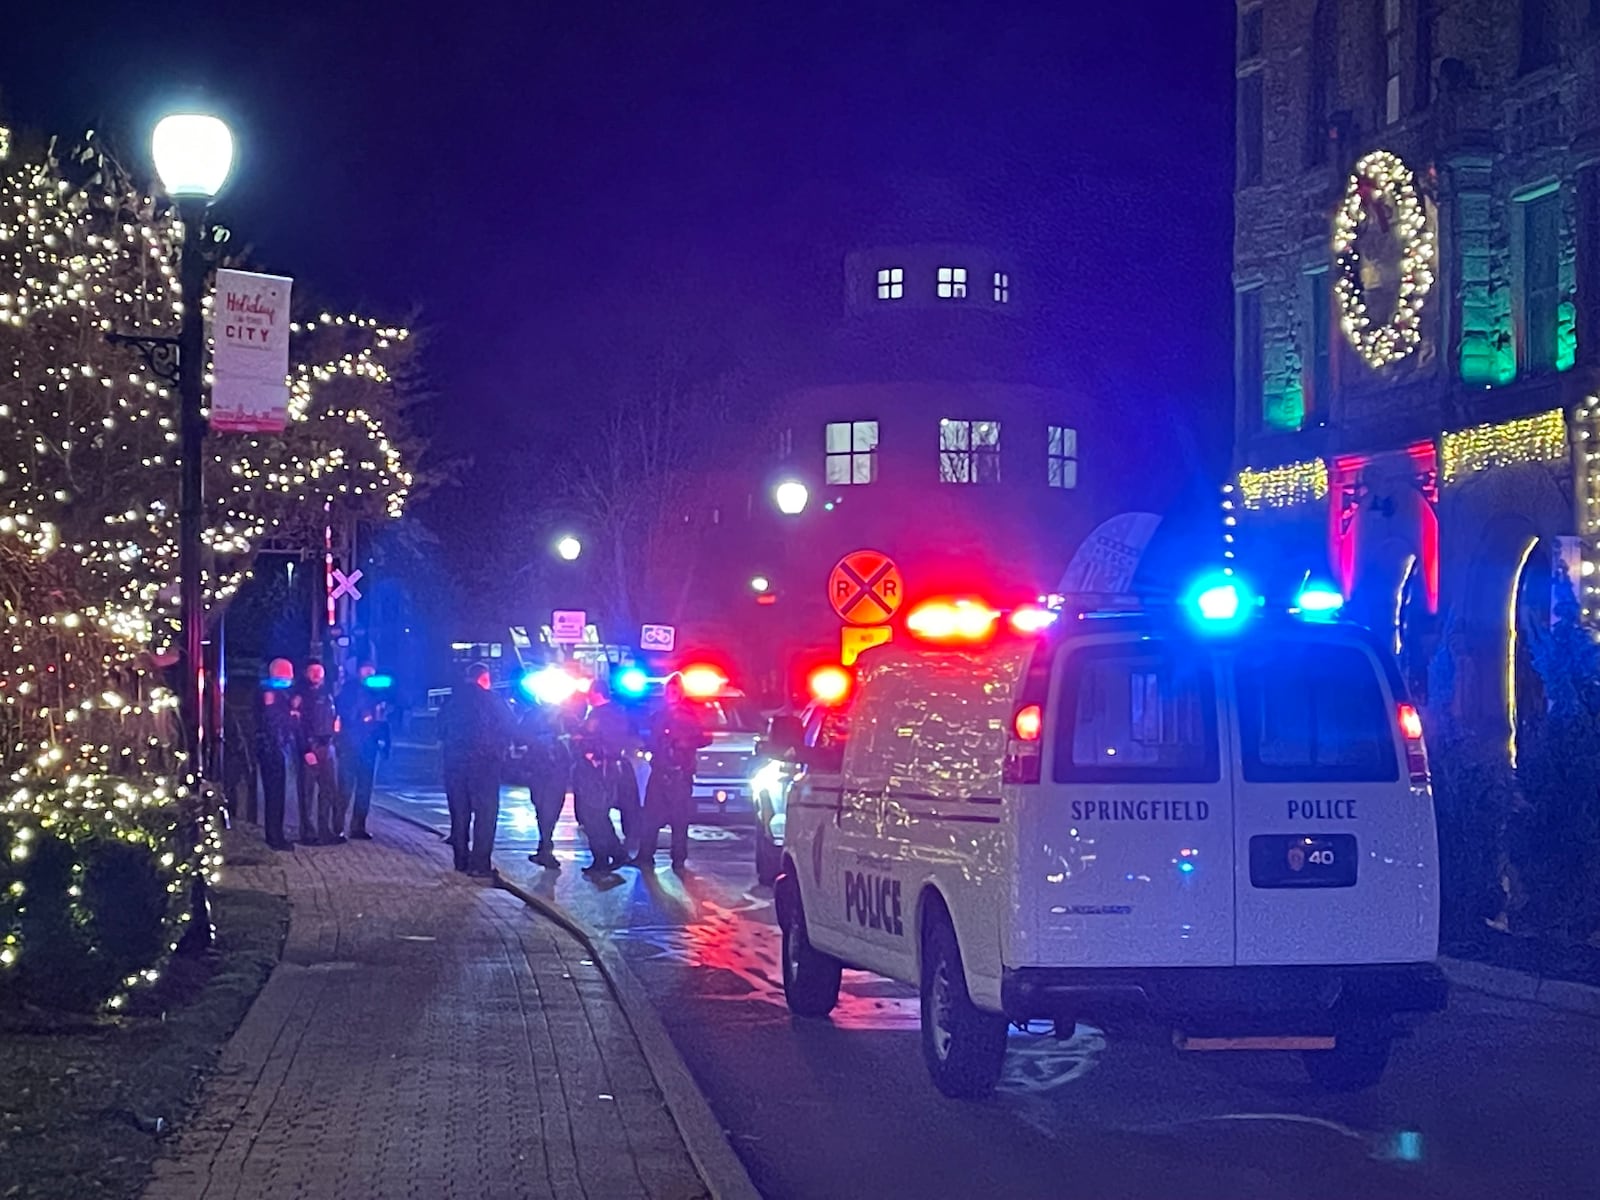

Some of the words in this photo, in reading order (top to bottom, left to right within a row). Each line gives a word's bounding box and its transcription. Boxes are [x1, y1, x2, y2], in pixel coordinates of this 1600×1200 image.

[226, 325, 270, 342] CITY
[837, 581, 850, 597] R
[883, 580, 897, 596] R
[1071, 800, 1209, 821] SPRINGFIELD
[1287, 799, 1358, 820] POLICE
[1308, 850, 1335, 865] 40
[845, 870, 904, 937] POLICE
